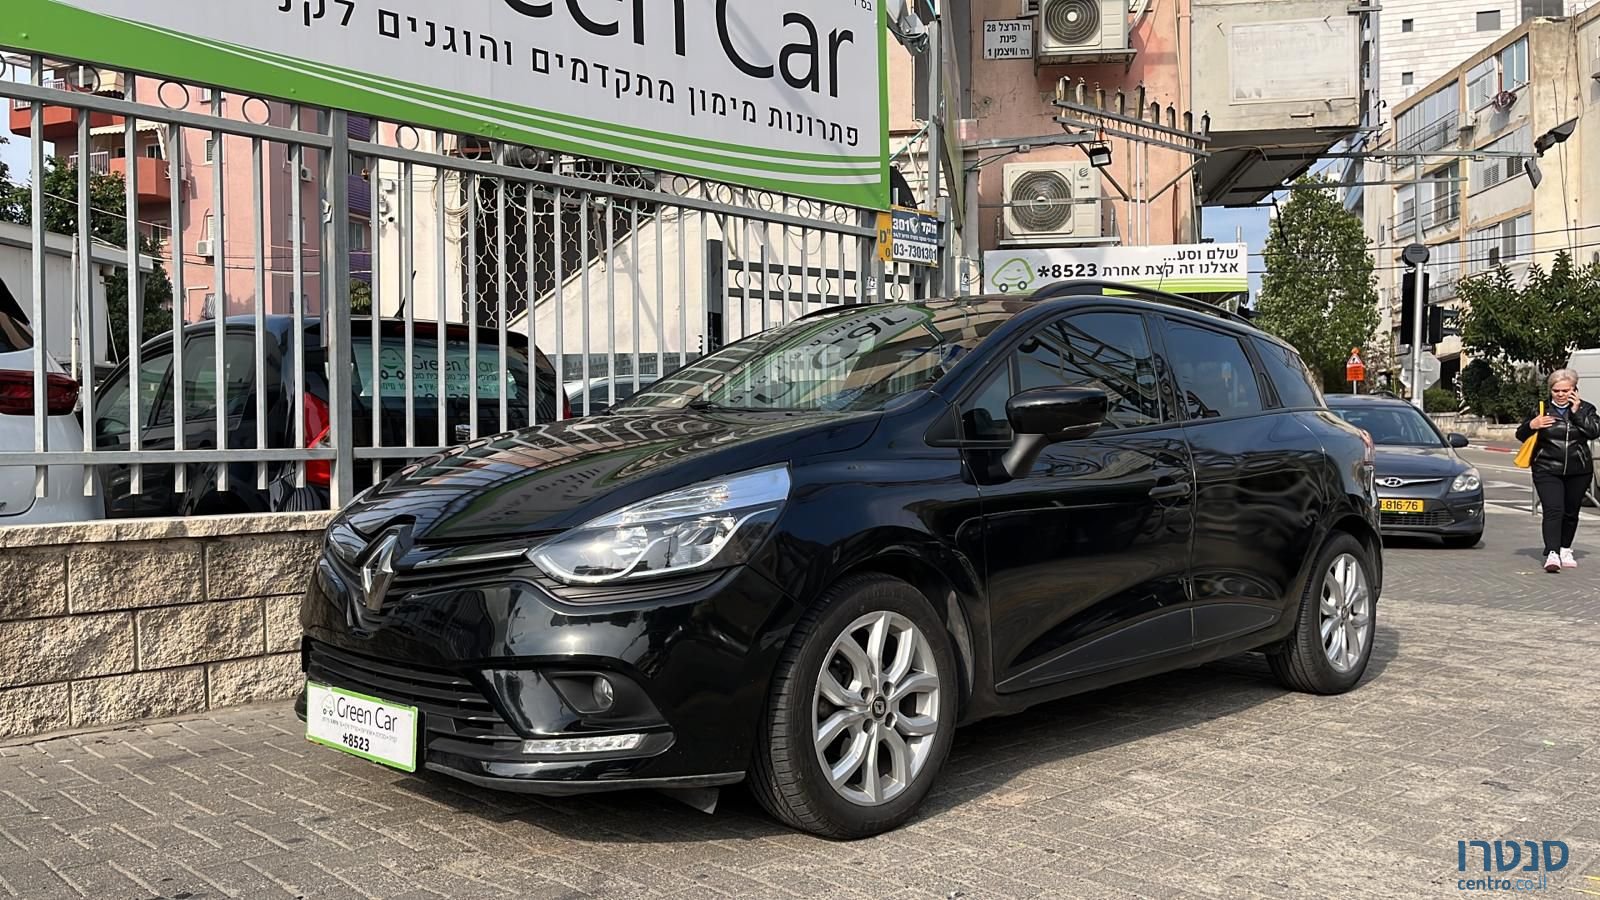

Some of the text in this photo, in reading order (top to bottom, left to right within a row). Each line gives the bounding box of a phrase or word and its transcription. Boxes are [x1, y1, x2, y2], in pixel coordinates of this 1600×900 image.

[986, 24, 996, 32] 28
[999, 22, 1020, 31] הרצל
[378, 9, 513, 66] והוגנים
[1000, 35, 1017, 43] פינת
[716, 0, 854, 98] Car
[987, 48, 992, 56] 1
[532, 48, 674, 104] מתקדמים
[688, 87, 757, 123] מימון
[767, 107, 859, 147] פתרונות
[892, 217, 910, 232] 301
[893, 242, 937, 261] 03-7301301
[1206, 247, 1238, 260] שלם
[1102, 265, 1140, 277] אחרת
[1144, 264, 1174, 278] קצת
[1179, 263, 1195, 274] זה
[1199, 261, 1239, 274] אצלנו
[336, 697, 372, 726] Green
[375, 707, 398, 732] Car
